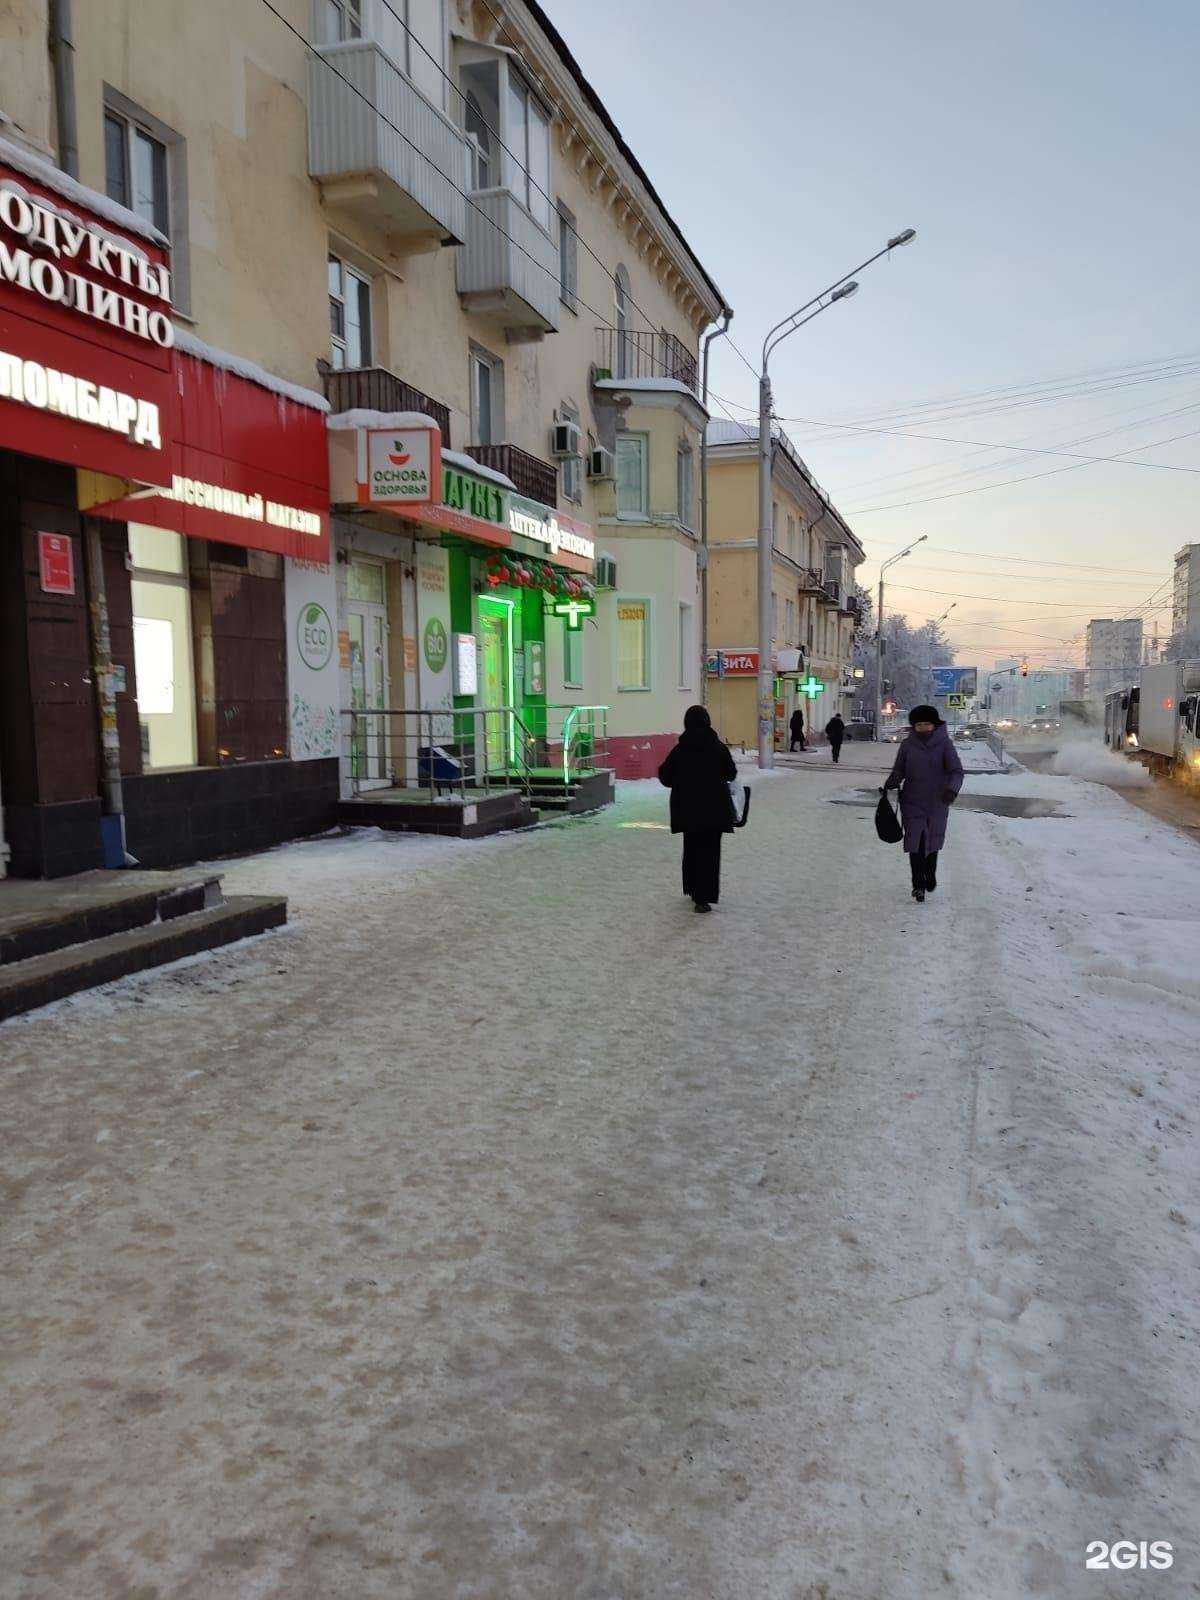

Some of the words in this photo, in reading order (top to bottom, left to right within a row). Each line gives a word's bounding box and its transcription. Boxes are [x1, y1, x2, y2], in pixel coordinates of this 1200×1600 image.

[0, 190, 172, 303] ОДУКТЫ
[0, 240, 175, 348] МОЛИНО
[374, 470, 428, 481] ОСНОВА
[374, 484, 428, 496] ЗДОРОВЬЯ
[443, 469, 507, 522] АРКЕТ
[510, 510, 551, 545] АПТЕКА
[304, 627, 328, 645] ECO
[427, 635, 444, 654] BIO
